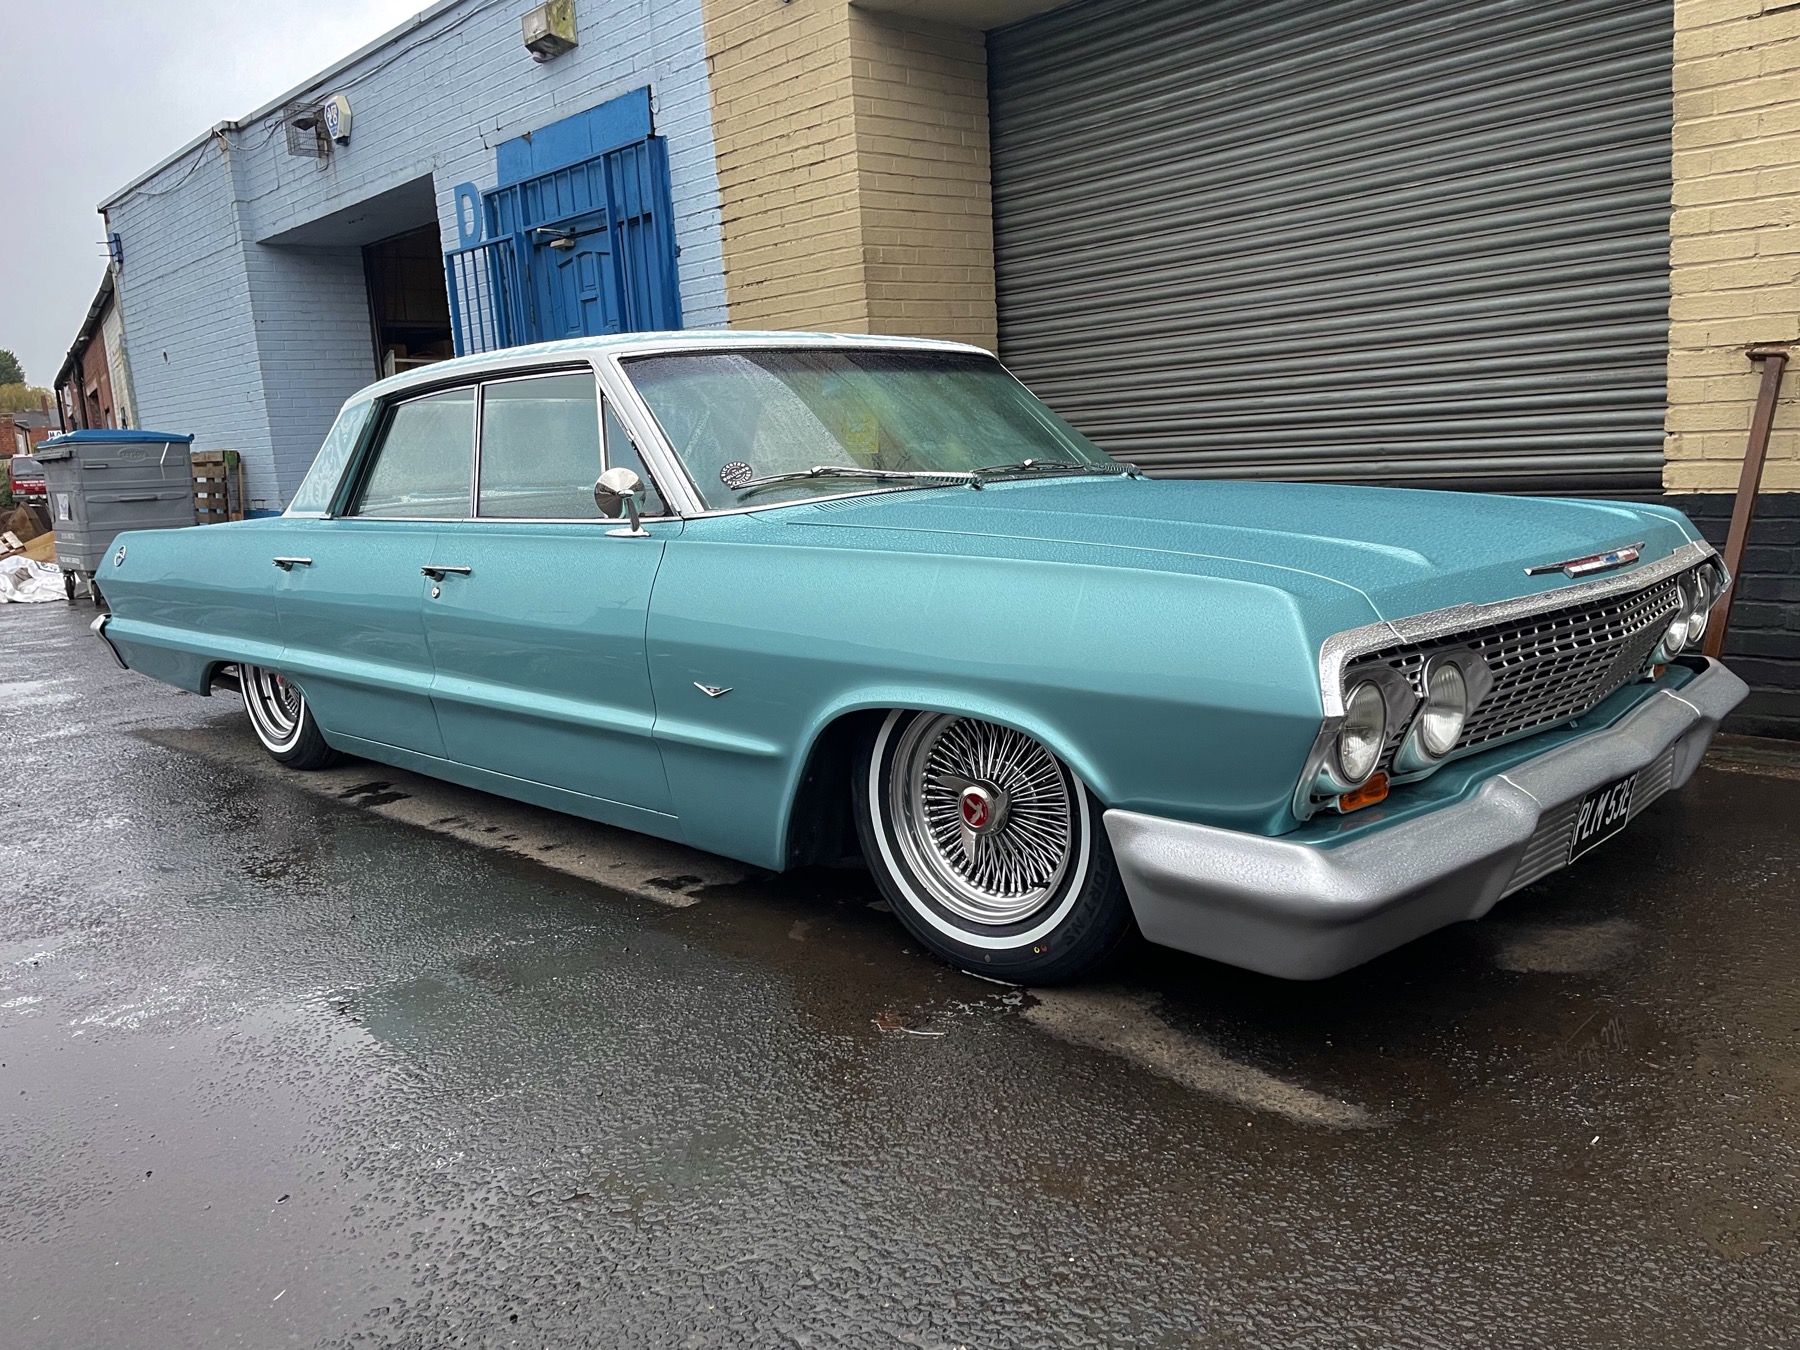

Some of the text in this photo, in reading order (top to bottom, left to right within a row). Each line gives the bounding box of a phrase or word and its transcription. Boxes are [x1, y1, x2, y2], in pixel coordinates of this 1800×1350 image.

[454, 182, 483, 249] D
[1574, 774, 1637, 846] PLM 532E
